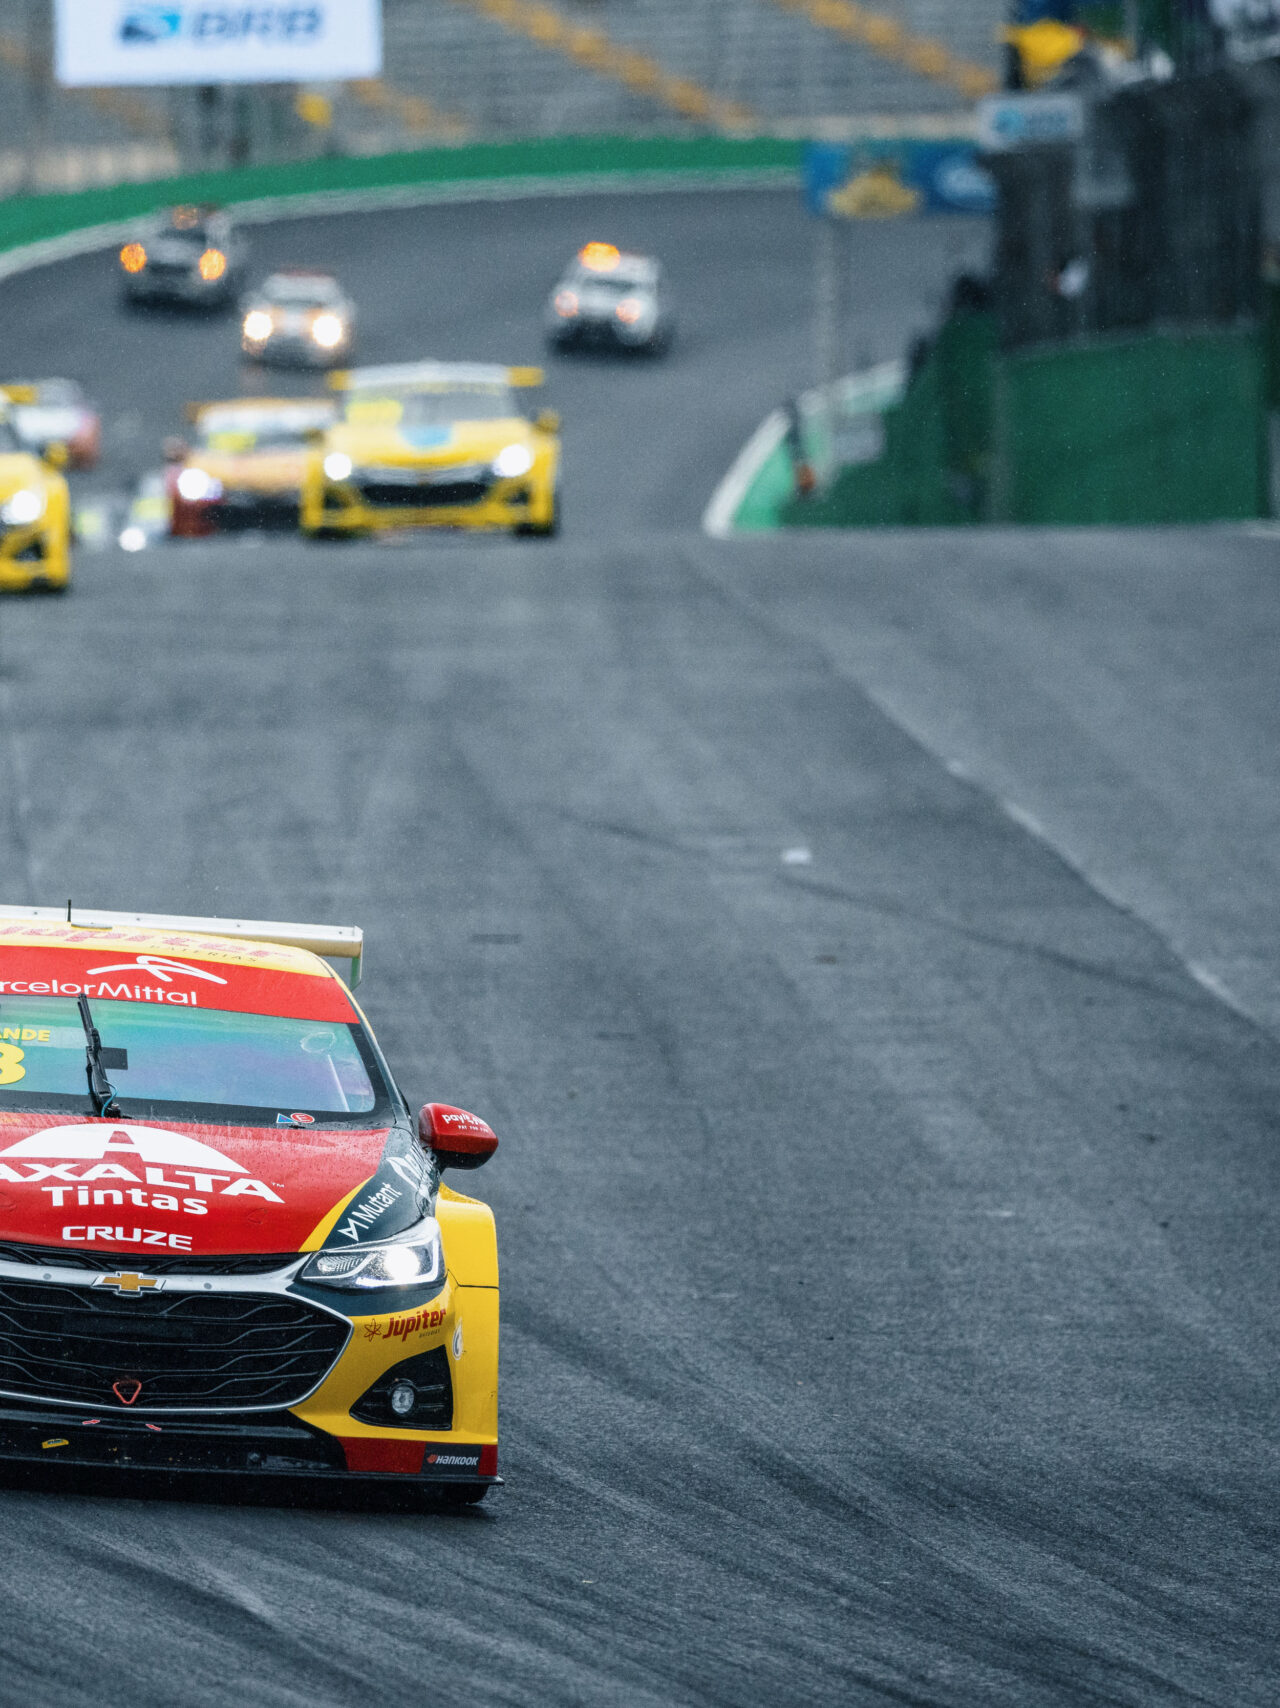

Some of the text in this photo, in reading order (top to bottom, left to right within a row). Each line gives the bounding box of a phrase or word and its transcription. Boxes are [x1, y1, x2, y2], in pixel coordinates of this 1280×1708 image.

[192, 8, 322, 44] BRB
[41, 1186, 208, 1215] Tintas
[351, 1182, 403, 1224] Mutant
[62, 1226, 193, 1251] CRUZE
